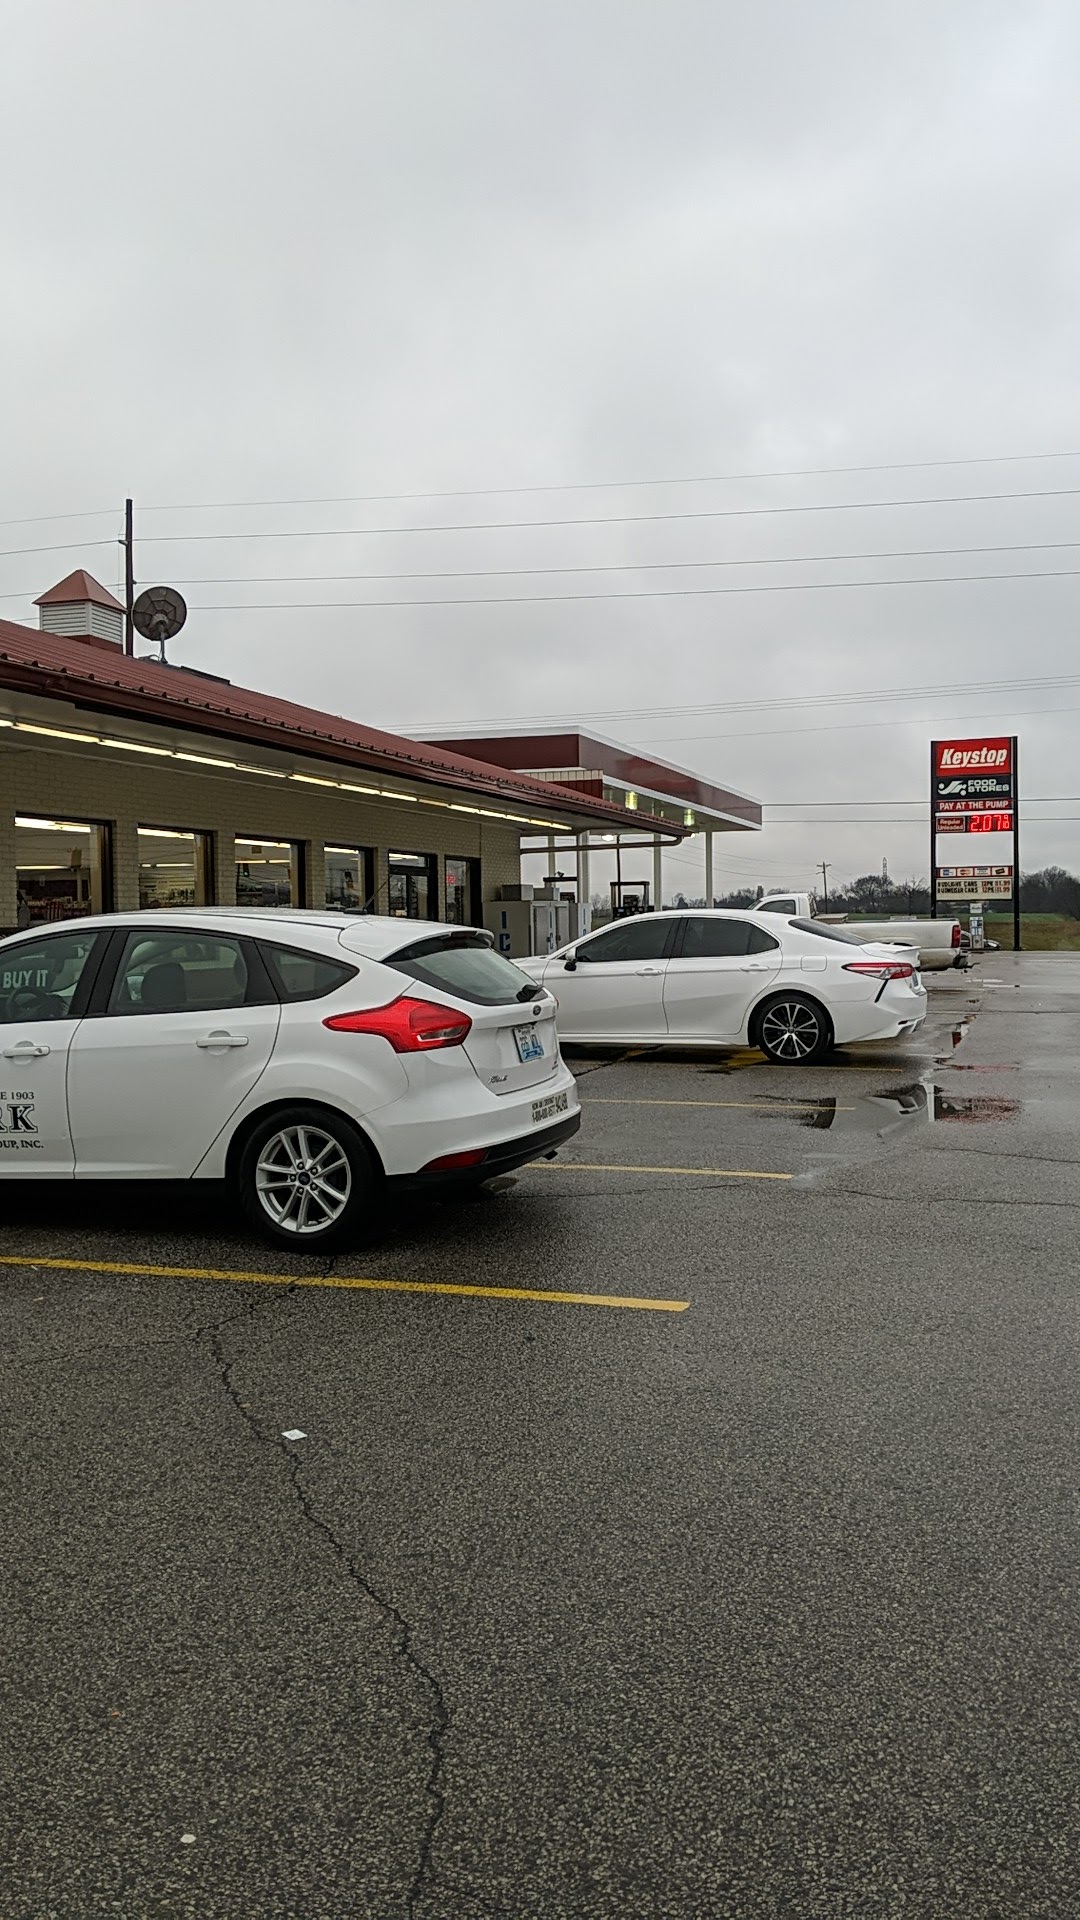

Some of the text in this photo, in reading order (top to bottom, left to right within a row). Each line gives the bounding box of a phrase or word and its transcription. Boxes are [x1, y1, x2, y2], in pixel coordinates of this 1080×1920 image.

[941, 747, 1008, 768] Keystop
[968, 784, 1009, 792] STORES
[956, 802, 967, 810] AT
[968, 801, 984, 809] THE
[985, 800, 1009, 808] PUMP
[3, 969, 48, 988] BUY IT
[11, 1091, 35, 1100] 1903
[20, 1140, 44, 1148] INC.
